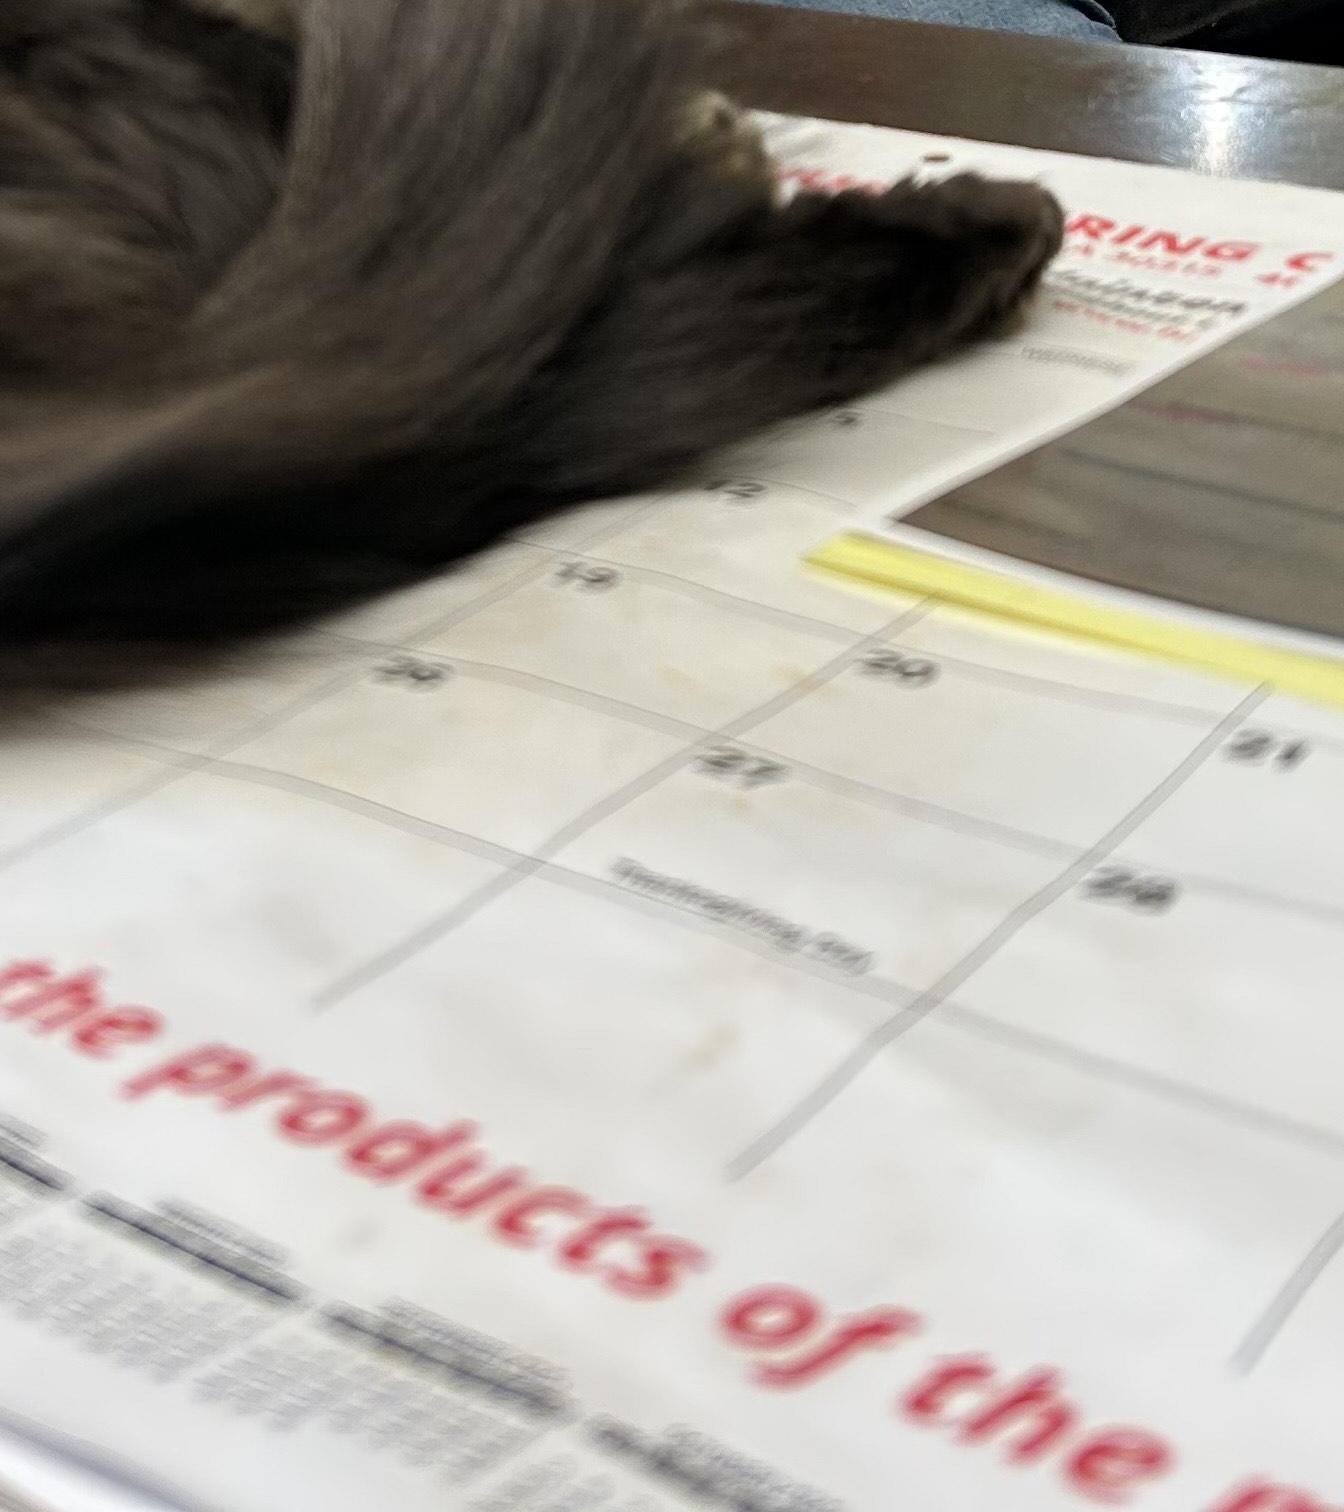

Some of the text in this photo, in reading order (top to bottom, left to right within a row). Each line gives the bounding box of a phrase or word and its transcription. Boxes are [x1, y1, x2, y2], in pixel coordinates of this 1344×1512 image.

[1065, 212, 1262, 262] RING
[1218, 726, 1310, 772] 21
[116, 1042, 713, 1303] products
[717, 1283, 926, 1392] of
[897, 1350, 1176, 1508] the
